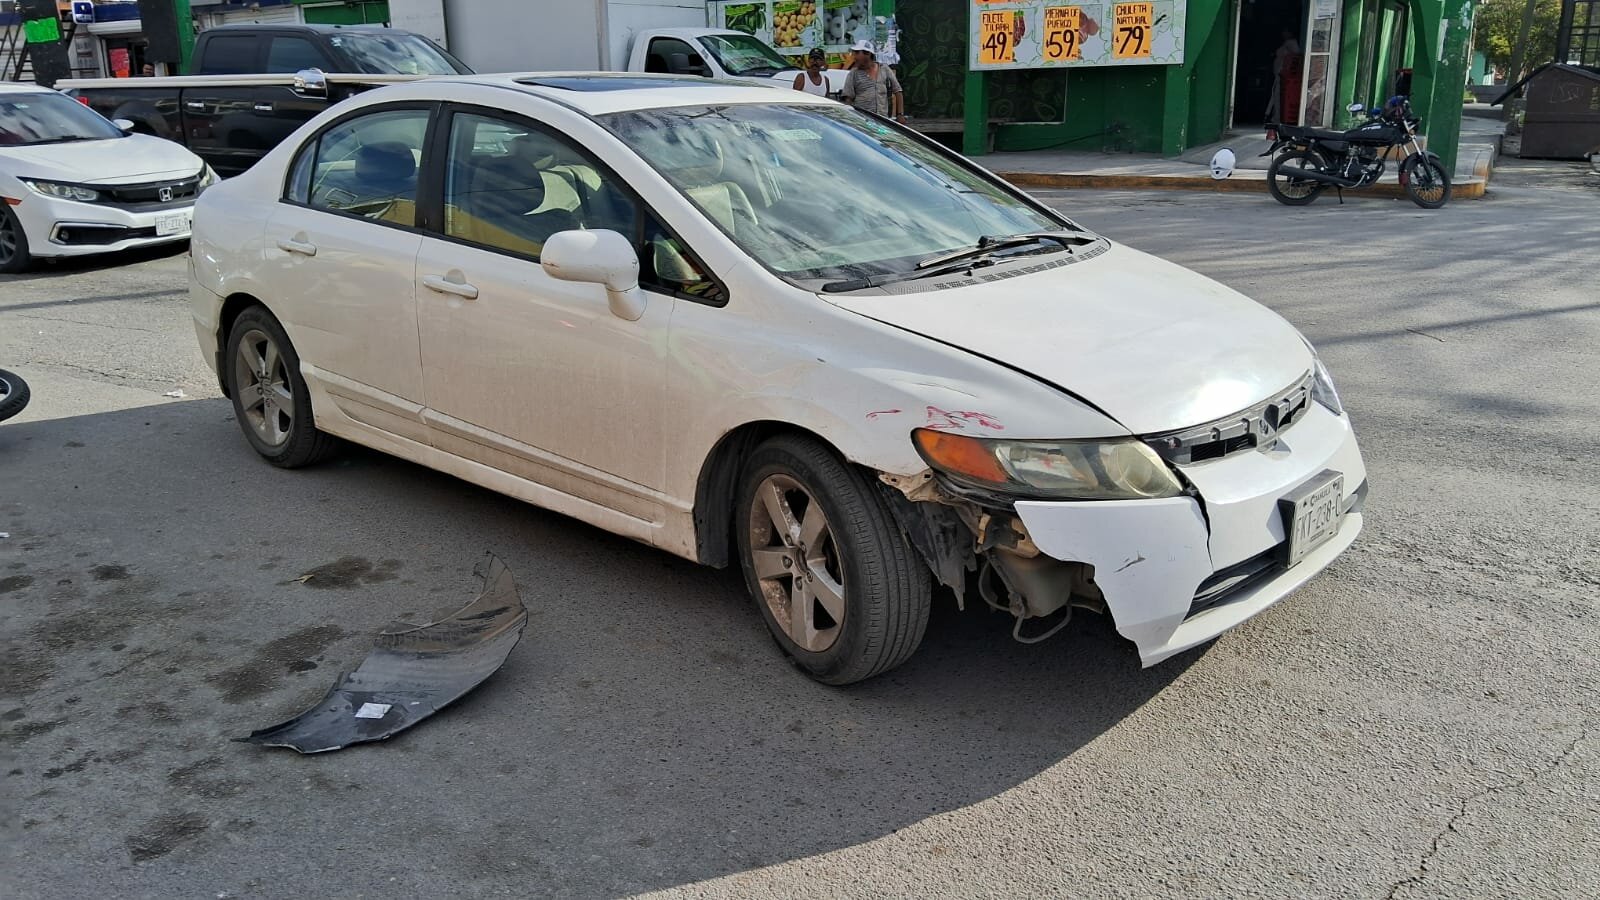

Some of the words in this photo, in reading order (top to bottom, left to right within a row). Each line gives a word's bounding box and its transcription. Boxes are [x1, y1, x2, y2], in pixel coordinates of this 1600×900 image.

[982, 13, 1004, 24] FILETE
[1045, 8, 1069, 19] PIERNA
[1116, 16, 1148, 25] NATURAL
